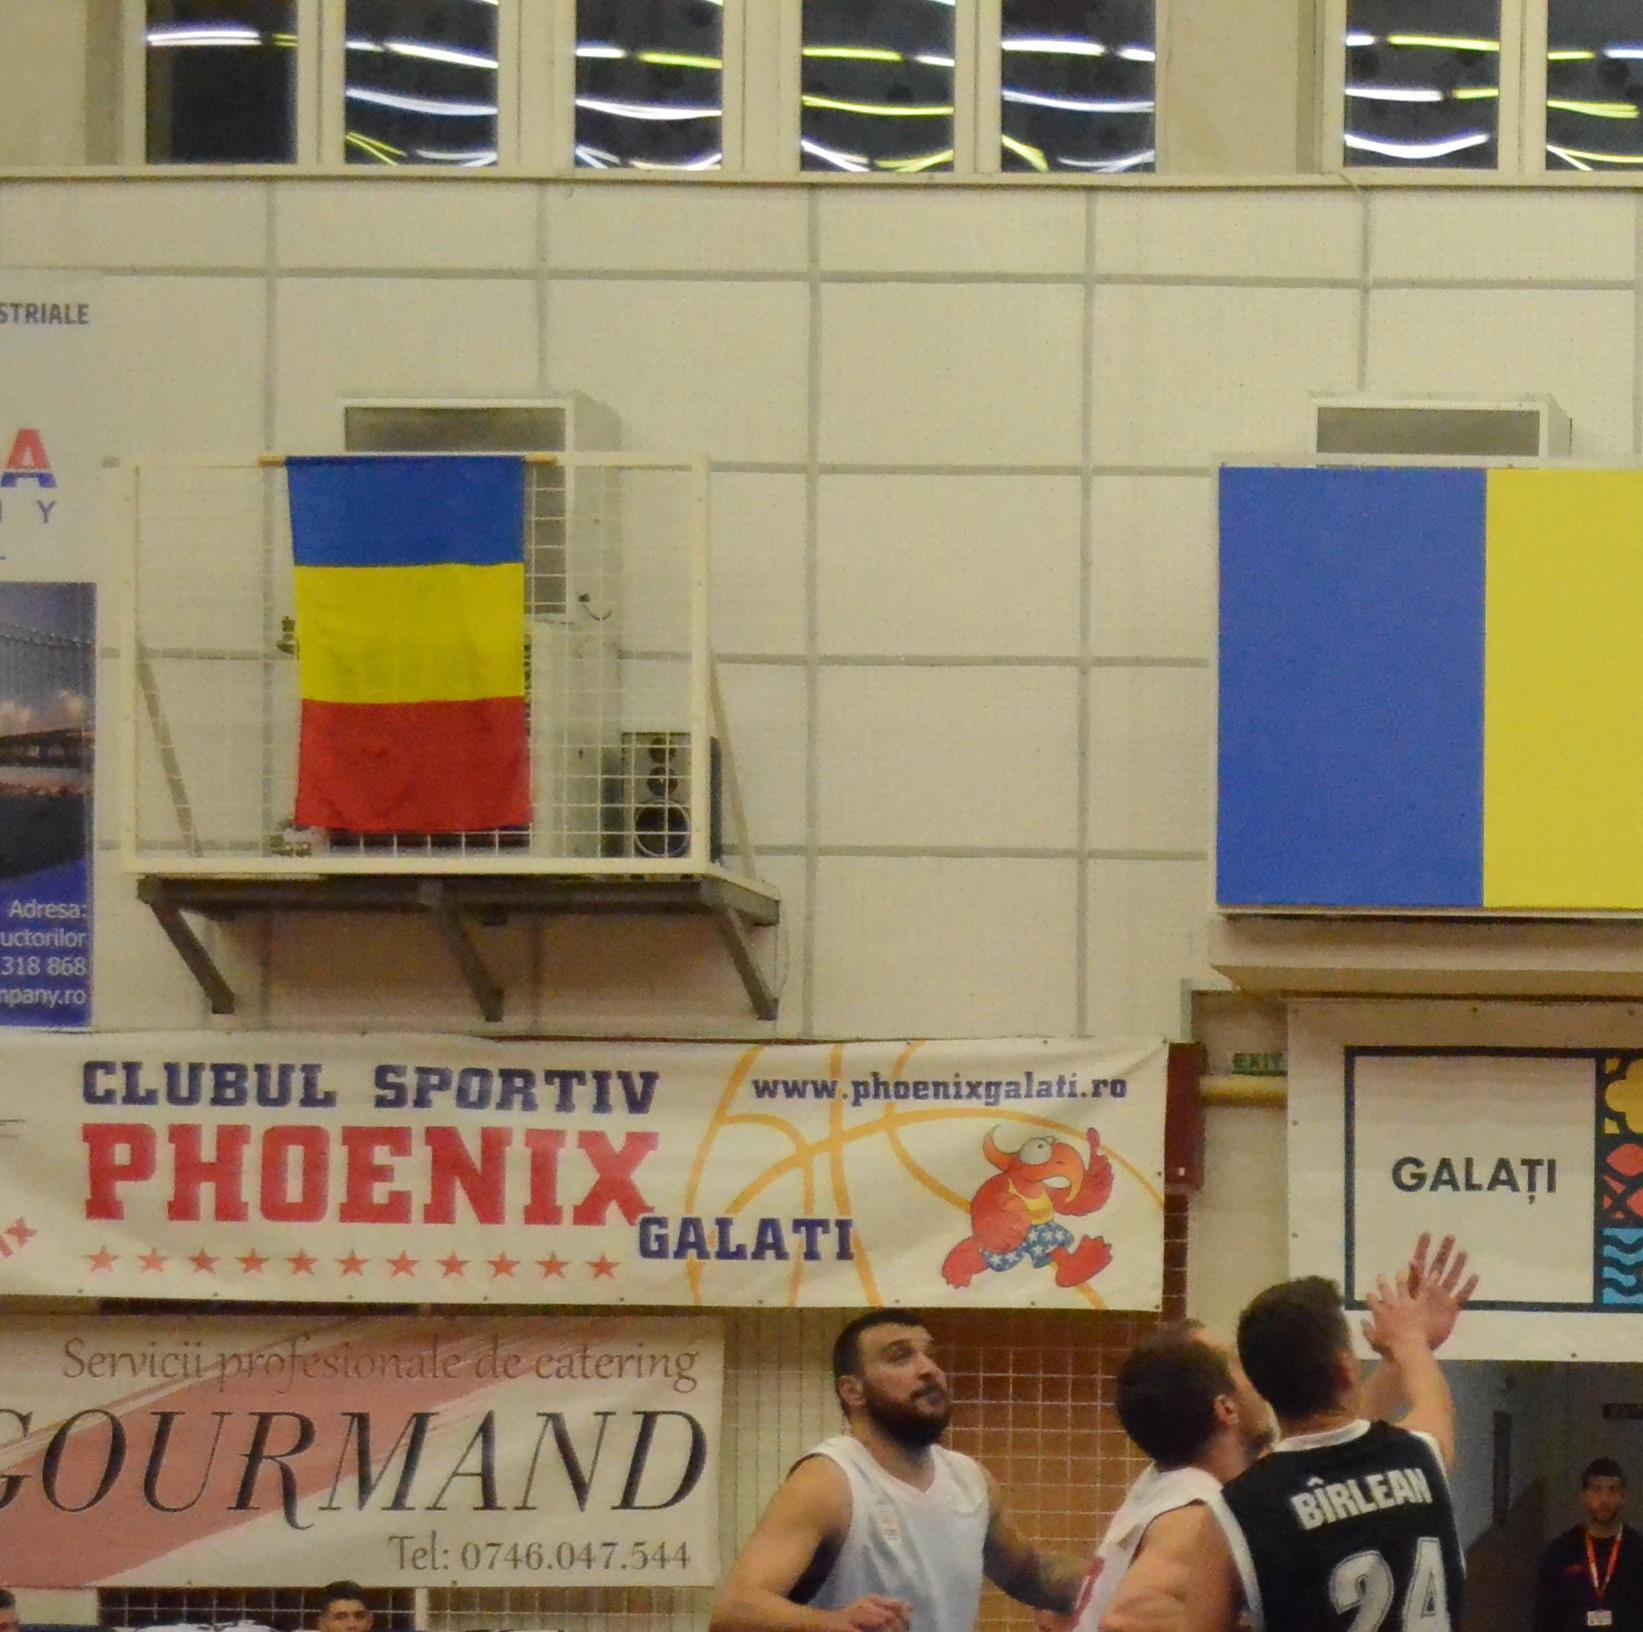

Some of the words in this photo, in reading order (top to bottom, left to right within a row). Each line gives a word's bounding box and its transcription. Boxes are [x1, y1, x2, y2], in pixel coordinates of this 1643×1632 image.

[9, 898, 87, 919] Adresa:
[2, 956, 40, 976] 318
[47, 956, 87, 977] 868
[82, 1061, 338, 1110] CLUBUL
[374, 1065, 660, 1115] SPORTIV
[751, 1074, 1128, 1111] www.phoenixgalati.ro
[82, 1124, 658, 1227] PHOENIX
[1392, 1157, 1556, 1204] GALAȚI
[636, 1216, 856, 1262] GALATI
[62, 1337, 203, 1379] Servicii
[216, 1335, 462, 1395] profesionale
[474, 1337, 519, 1380] de
[535, 1345, 699, 1393] catering
[1291, 1467, 1433, 1531] BÎRLEAN
[389, 1532, 450, 1572] Tel:
[461, 1540, 692, 1572] 0746.047.544
